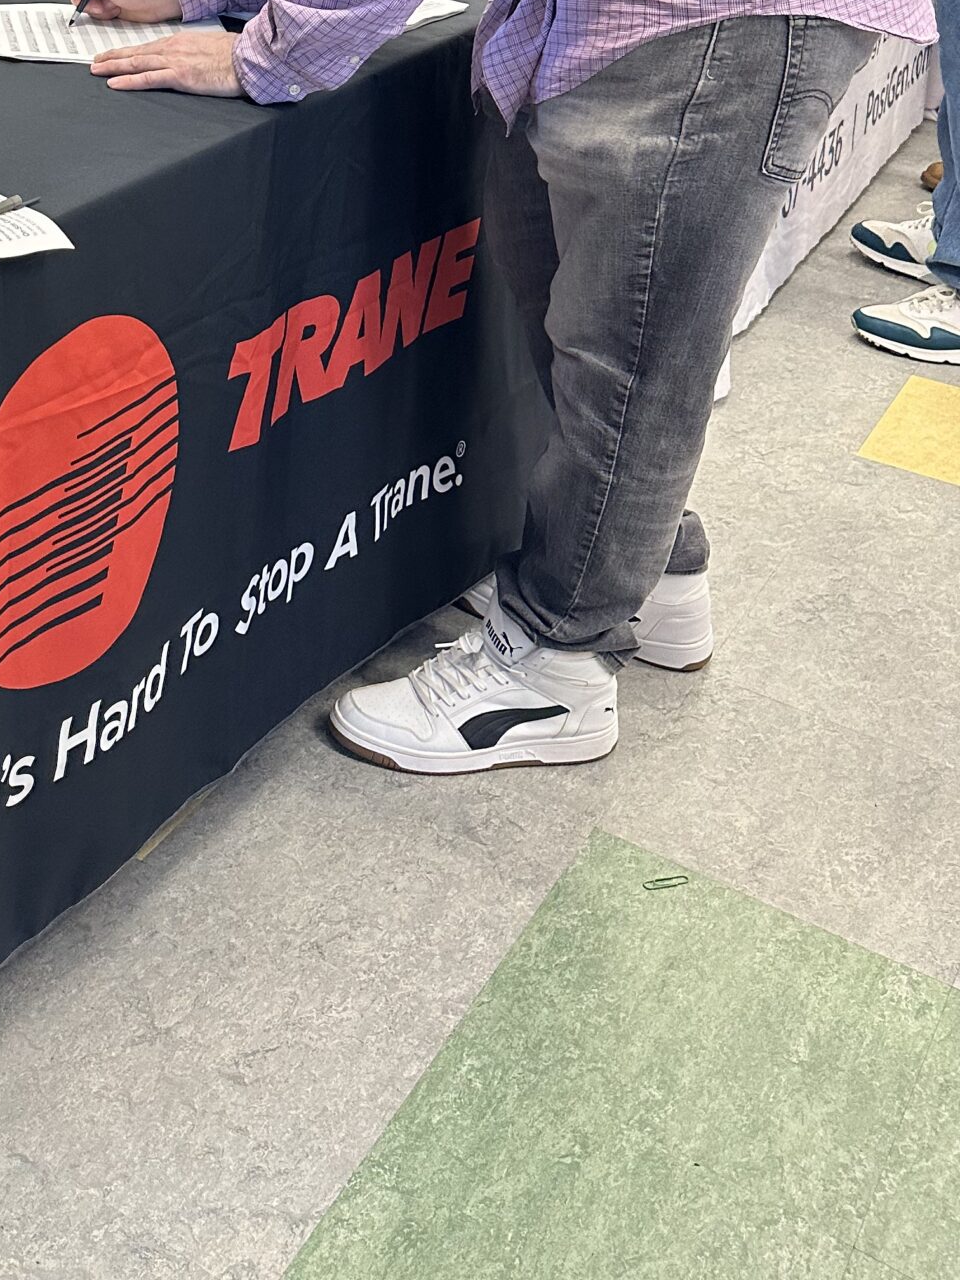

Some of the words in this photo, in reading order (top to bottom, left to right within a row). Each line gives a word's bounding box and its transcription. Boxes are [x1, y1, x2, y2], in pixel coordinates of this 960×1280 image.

[227, 217, 482, 453] TRANE
[53, 640, 170, 783] Hard
[179, 607, 219, 676] To
[235, 541, 314, 635] Stop
[324, 511, 358, 571] A
[485, 618, 508, 656] PUMA
